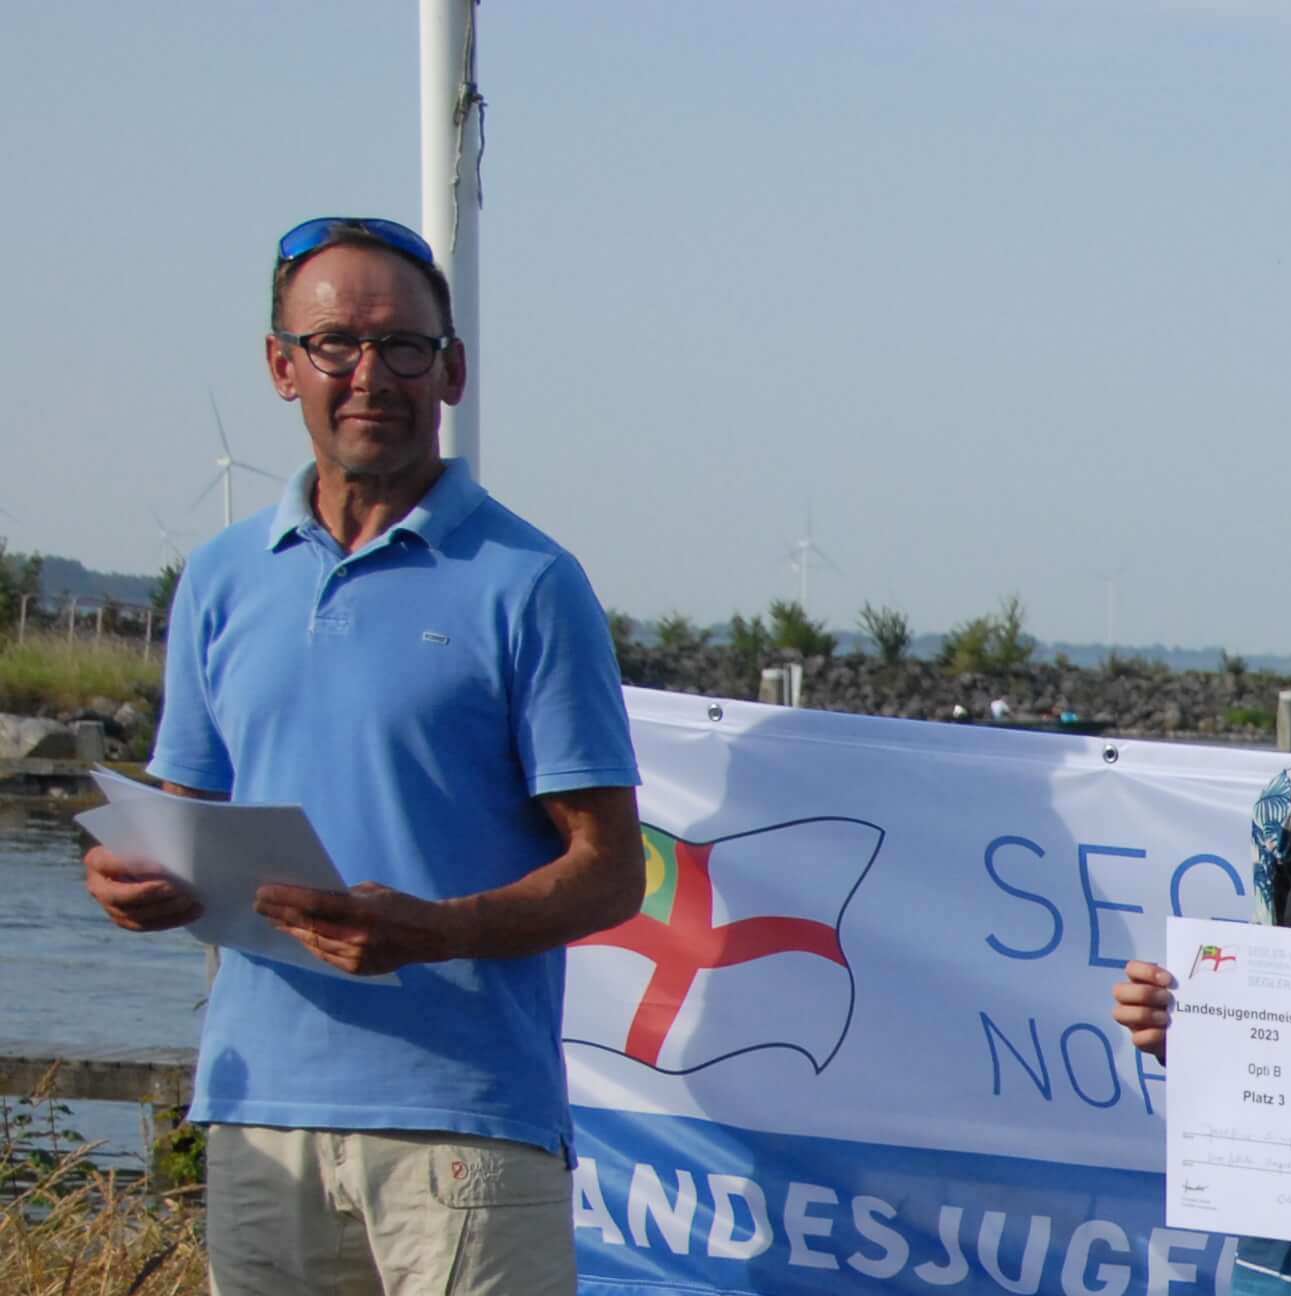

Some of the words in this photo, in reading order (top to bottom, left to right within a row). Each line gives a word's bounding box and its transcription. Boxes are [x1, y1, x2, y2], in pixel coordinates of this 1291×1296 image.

[1250, 1028, 1280, 1042] 2023
[1248, 1063, 1270, 1078] Opti
[1273, 1066, 1281, 1077] B
[1243, 1091, 1275, 1106] Platz
[1278, 1094, 1285, 1106] 3
